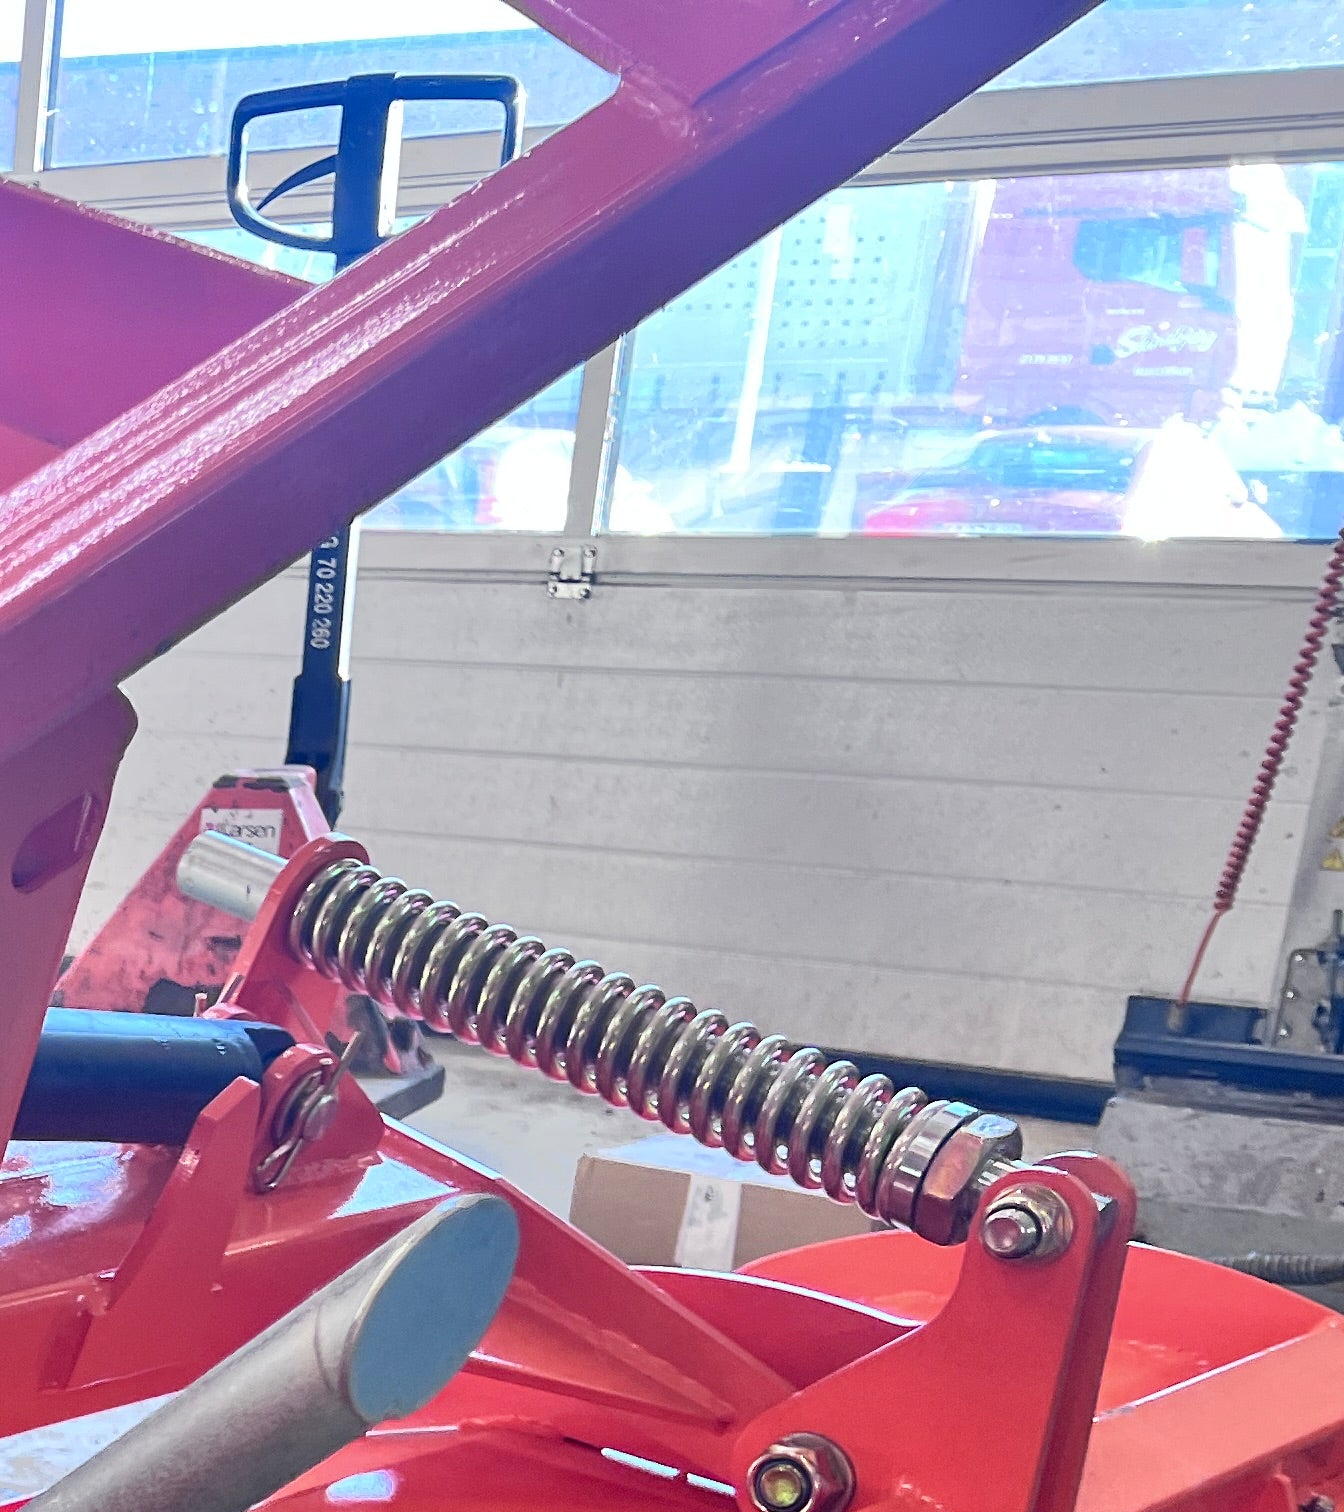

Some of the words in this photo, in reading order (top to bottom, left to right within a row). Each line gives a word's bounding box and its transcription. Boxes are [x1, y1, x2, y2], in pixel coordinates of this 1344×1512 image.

[316, 557, 337, 580] 70
[313, 582, 334, 614] 220
[310, 617, 332, 649] 260
